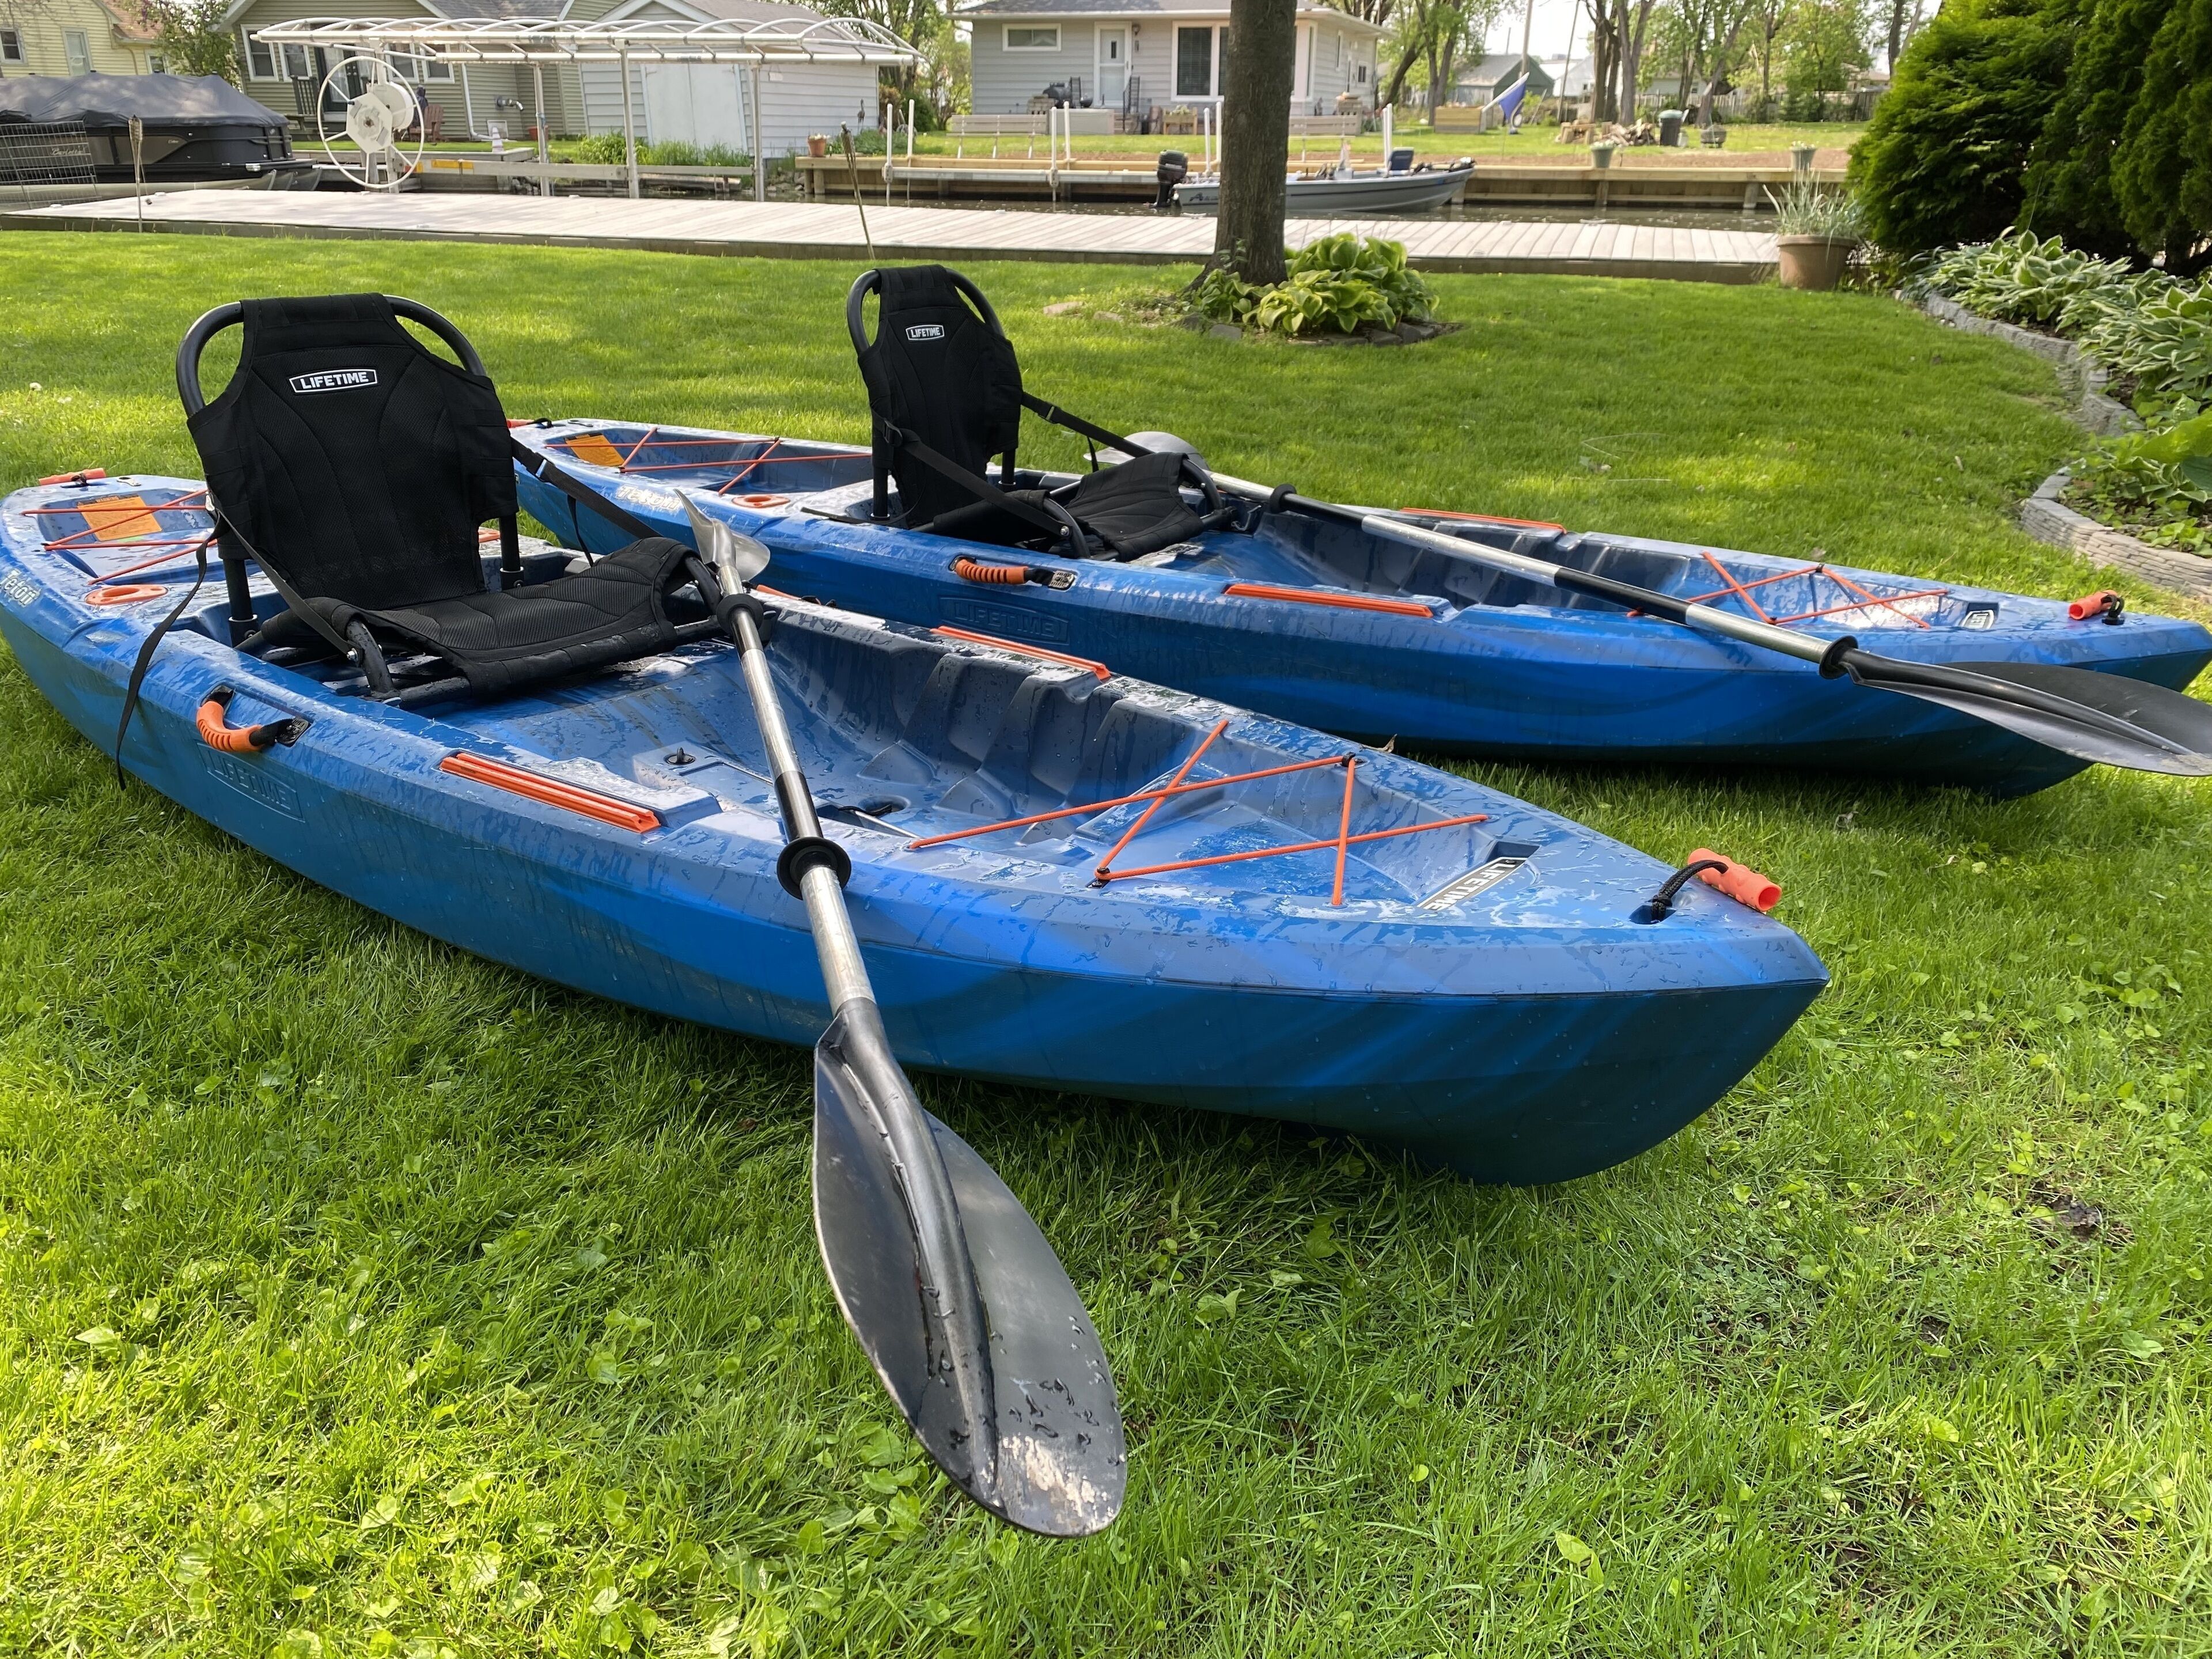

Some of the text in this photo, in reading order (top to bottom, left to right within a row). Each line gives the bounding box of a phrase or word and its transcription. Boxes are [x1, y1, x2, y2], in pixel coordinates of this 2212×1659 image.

[911, 327, 941, 338] LIFETIME
[300, 372, 369, 389] LIFETIME
[615, 484, 680, 510] Teton
[0, 569, 39, 607] Teton
[954, 602, 1055, 638] LIFETIME
[207, 749, 291, 810] LIFETIME
[1423, 863, 1516, 911] LIFETIME
